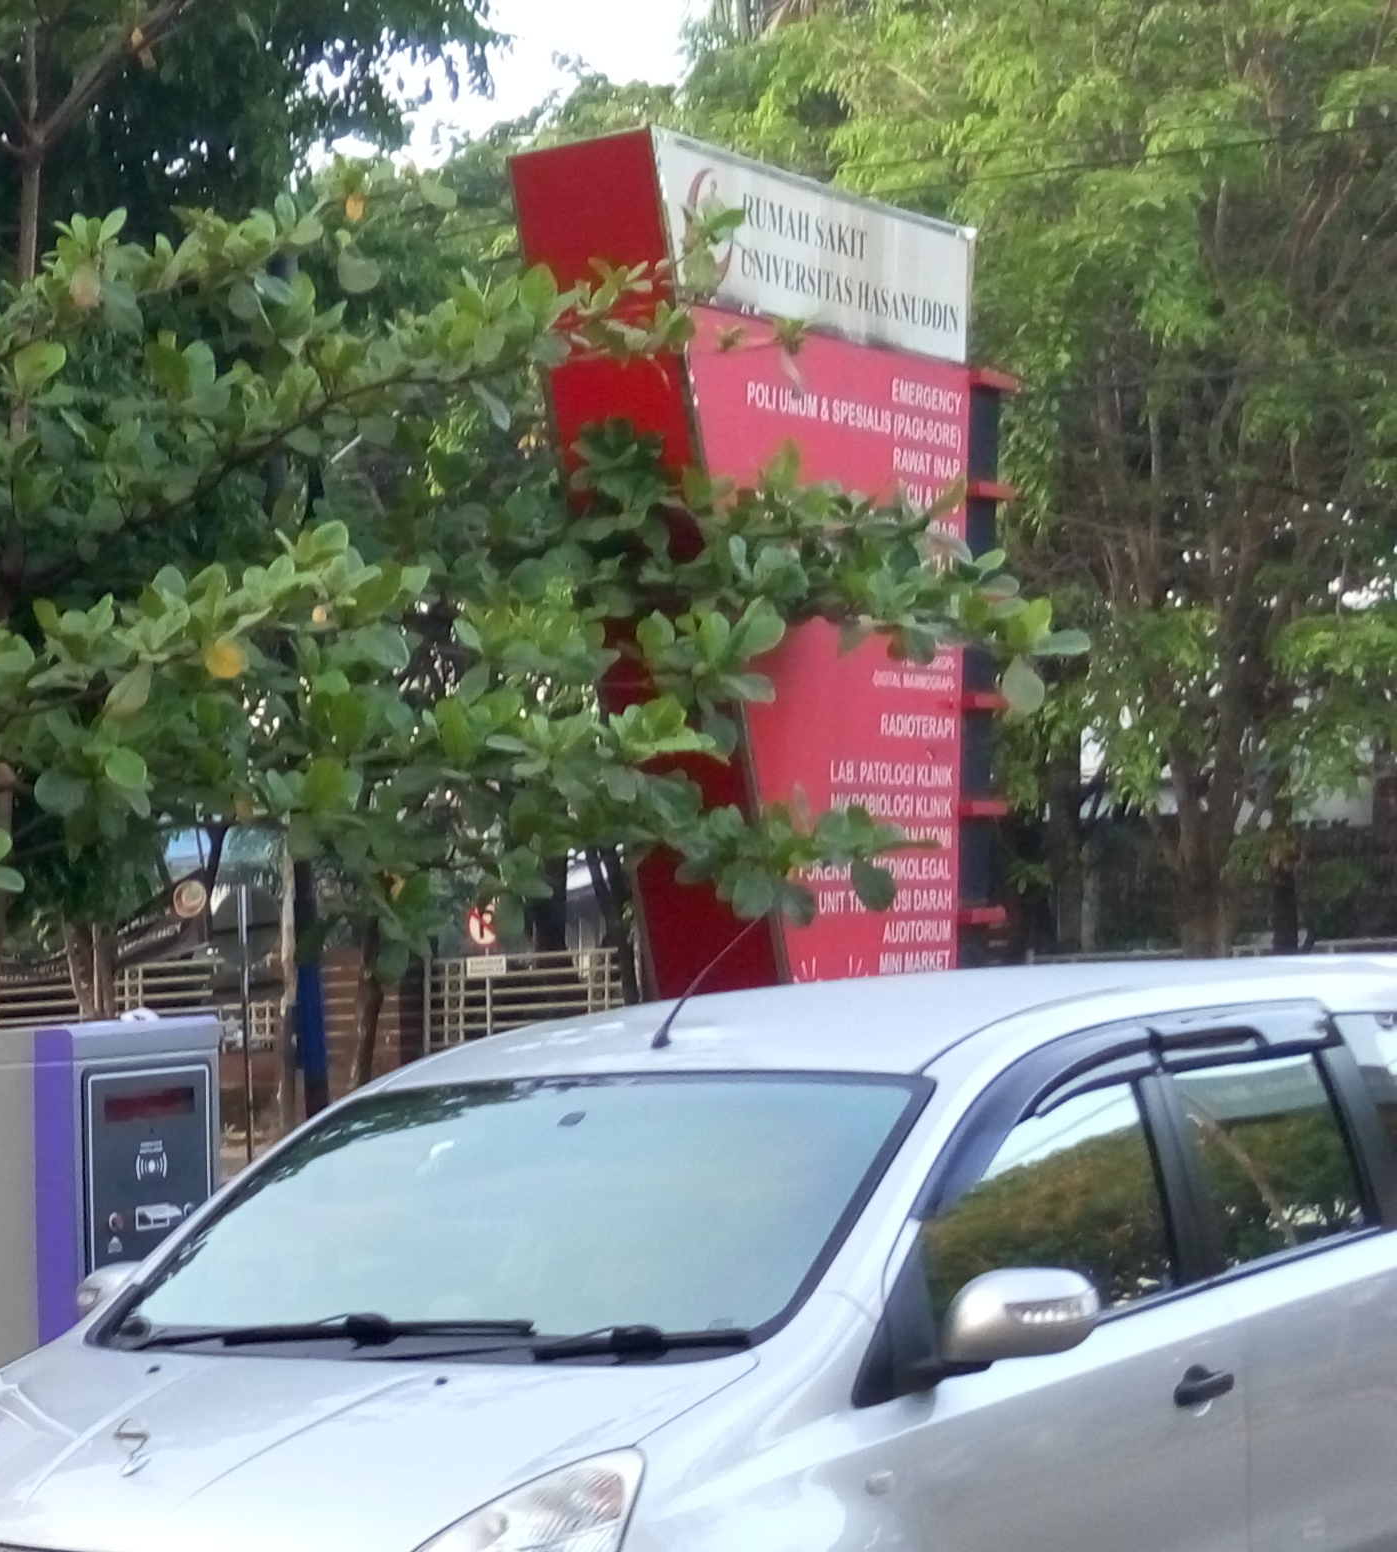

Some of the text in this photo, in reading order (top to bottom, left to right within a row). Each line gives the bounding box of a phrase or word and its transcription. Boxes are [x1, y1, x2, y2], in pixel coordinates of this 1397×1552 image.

[742, 193, 867, 261] RUMAH SAKIT
[741, 247, 959, 333] UNIVERSITAS HASANUDDIN
[891, 376, 963, 416] EMERGENCY
[746, 380, 962, 454] POLI UMUM & SPESIALIS (PAGI-SORE)
[893, 447, 960, 481] RAWAT INAP
[880, 713, 955, 740] RADIOTERAPI
[859, 761, 914, 786] PATOLOGI
[917, 764, 952, 788] KLINIK
[916, 795, 952, 819] KLINIK
[818, 890, 846, 915] UNIT
[914, 888, 952, 912] DARAH
[882, 918, 951, 944] AUDITORIUM
[879, 949, 951, 974] MINI MARKET
